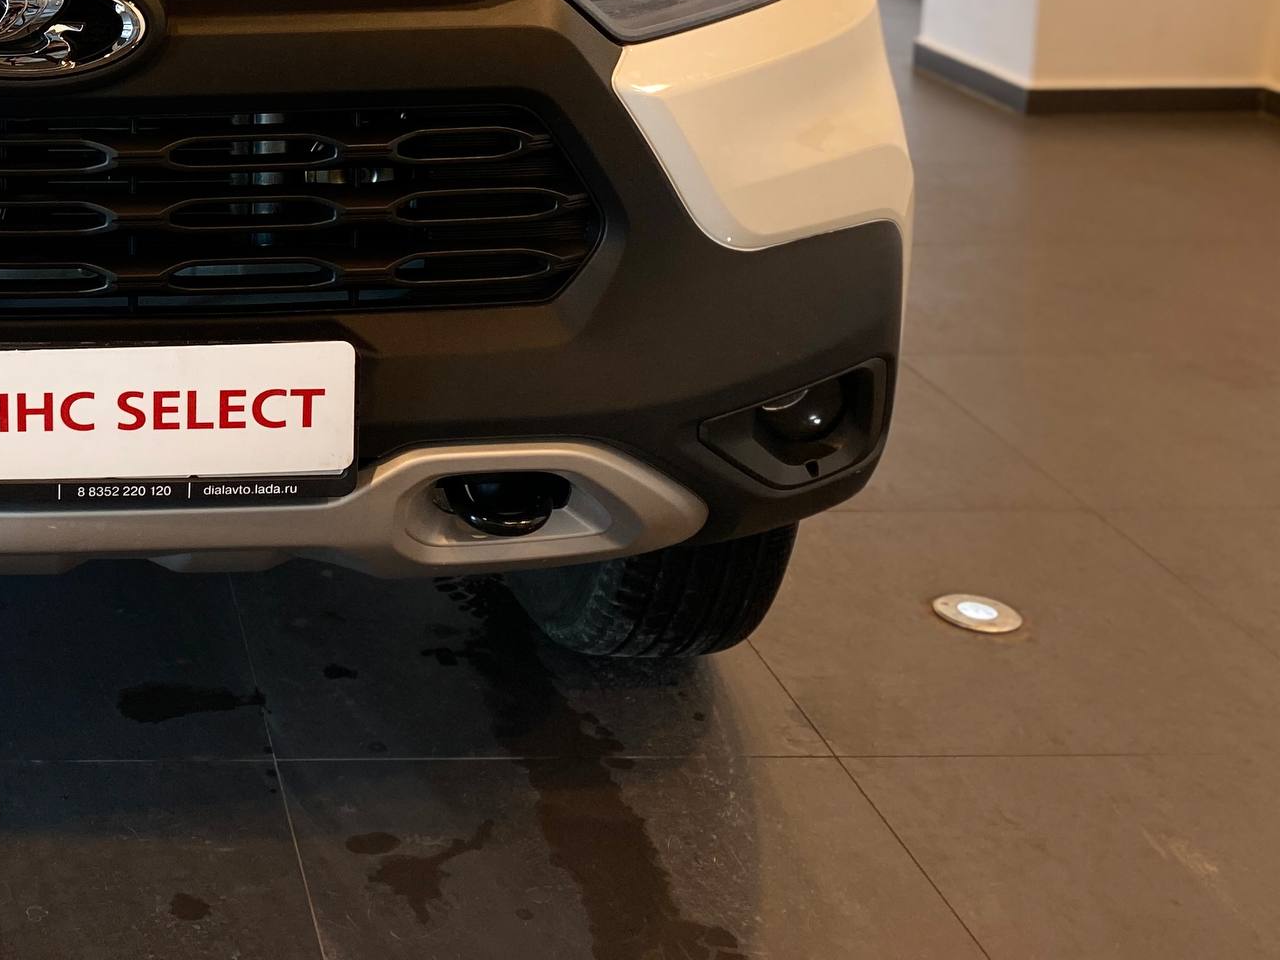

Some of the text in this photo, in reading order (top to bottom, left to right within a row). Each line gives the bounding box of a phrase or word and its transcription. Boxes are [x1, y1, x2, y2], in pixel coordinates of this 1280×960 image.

[116, 387, 327, 432] SELECT
[77, 485, 172, 497] 8 8352 220 120
[203, 483, 298, 496] dialavto.lada.ru
